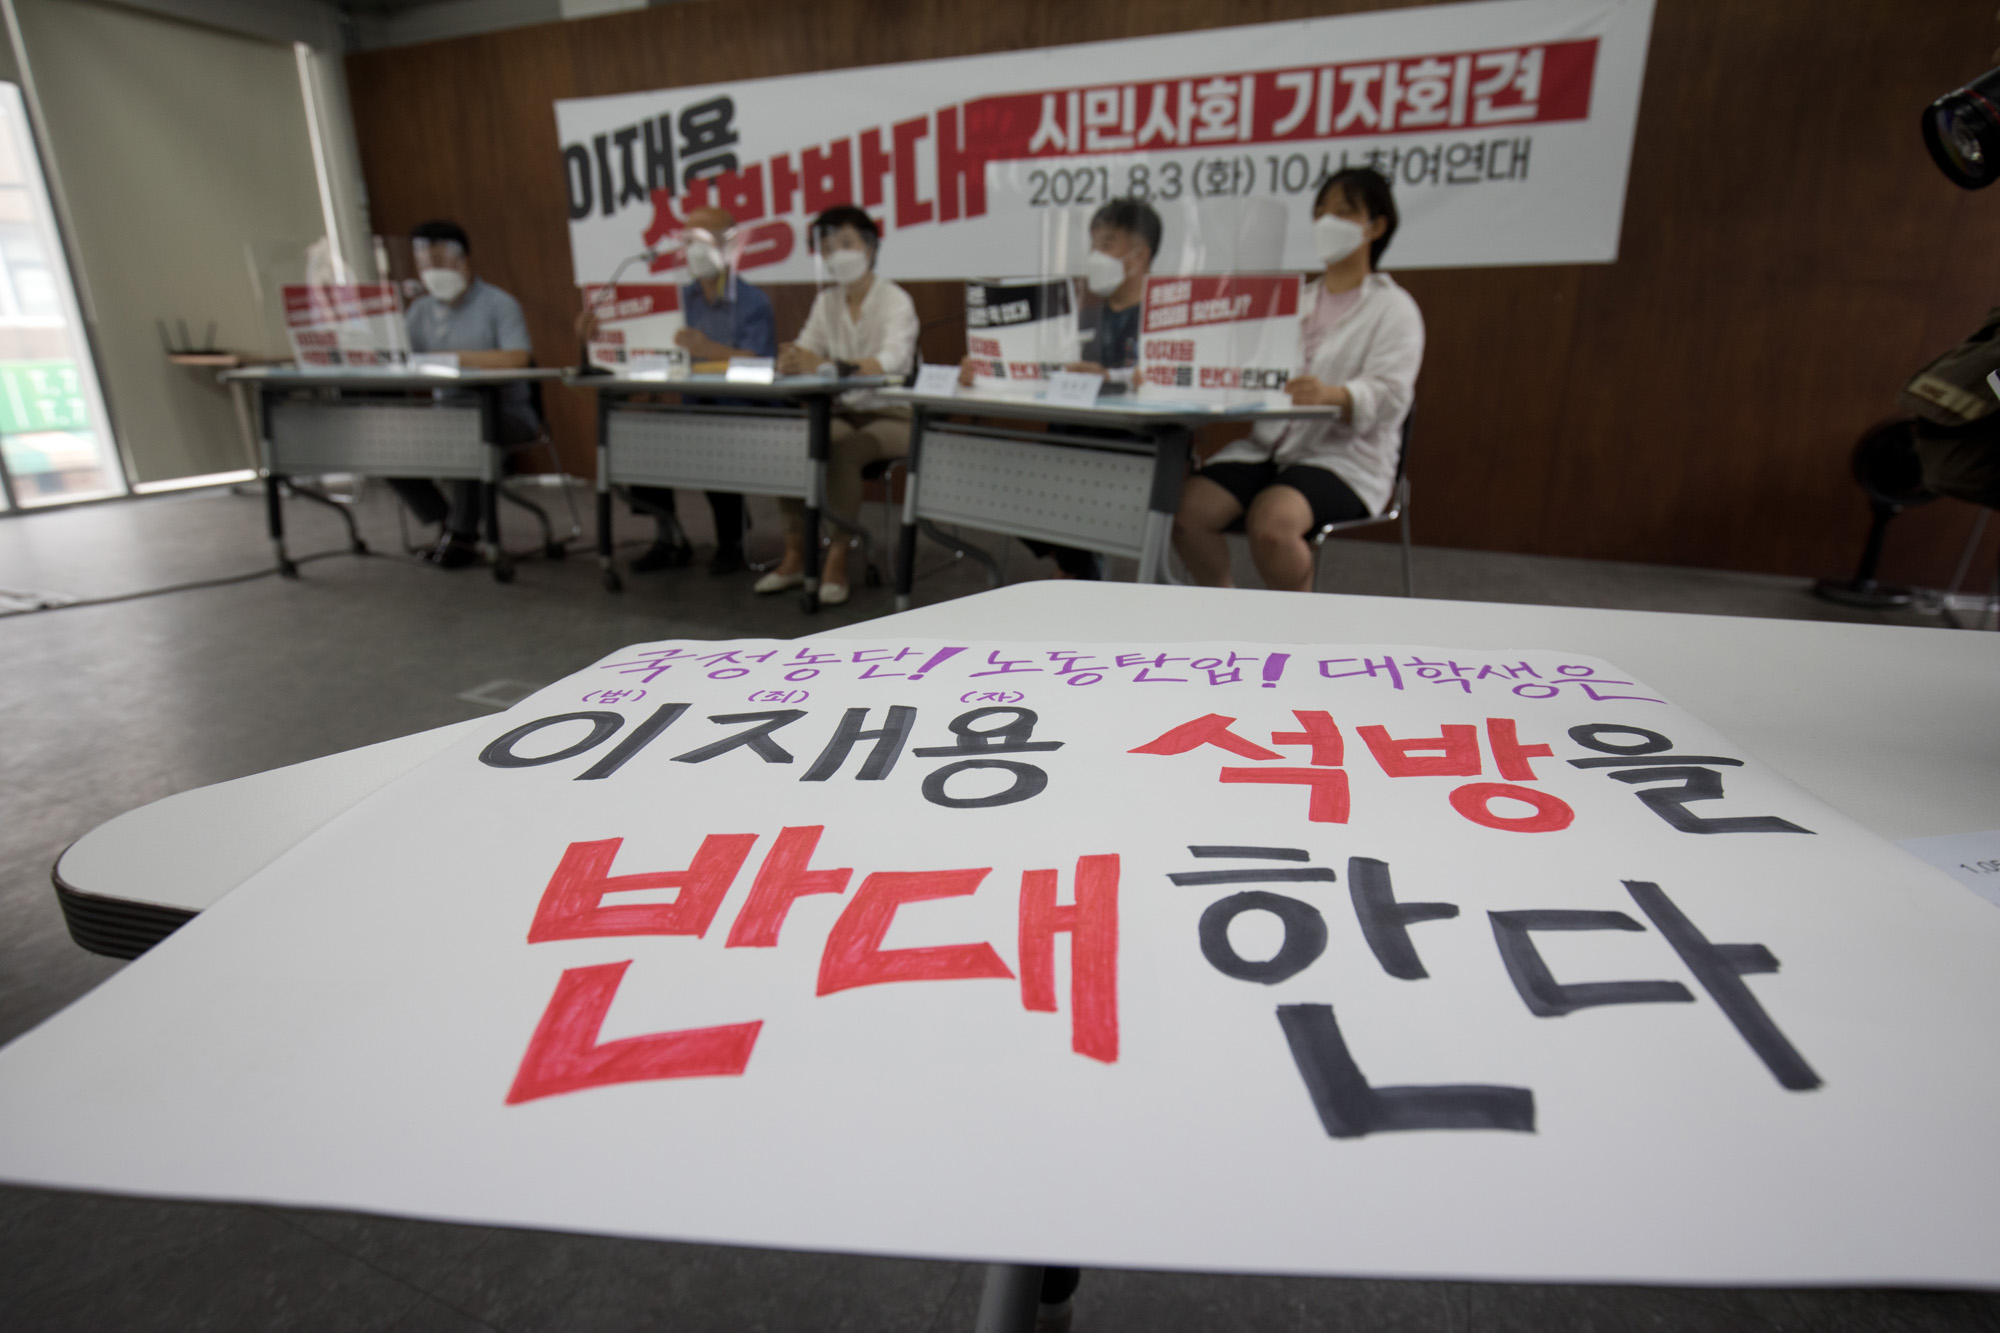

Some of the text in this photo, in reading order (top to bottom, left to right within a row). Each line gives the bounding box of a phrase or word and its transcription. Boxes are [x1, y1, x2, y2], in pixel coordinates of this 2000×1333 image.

[1028, 46, 1545, 154] 시민사회 기자회견
[563, 95, 740, 222] 이재용
[1127, 161, 1183, 200] 8.3
[1192, 155, 1256, 197] (화)
[581, 689, 648, 704] (범)
[600, 646, 1667, 704] 국정농단! 노동탄압! 대학생은
[747, 689, 811, 704] (죄)
[958, 689, 1026, 704] (자)
[477, 702, 1818, 835] 이재용 석방을
[504, 824, 1825, 1140] 반대한다
